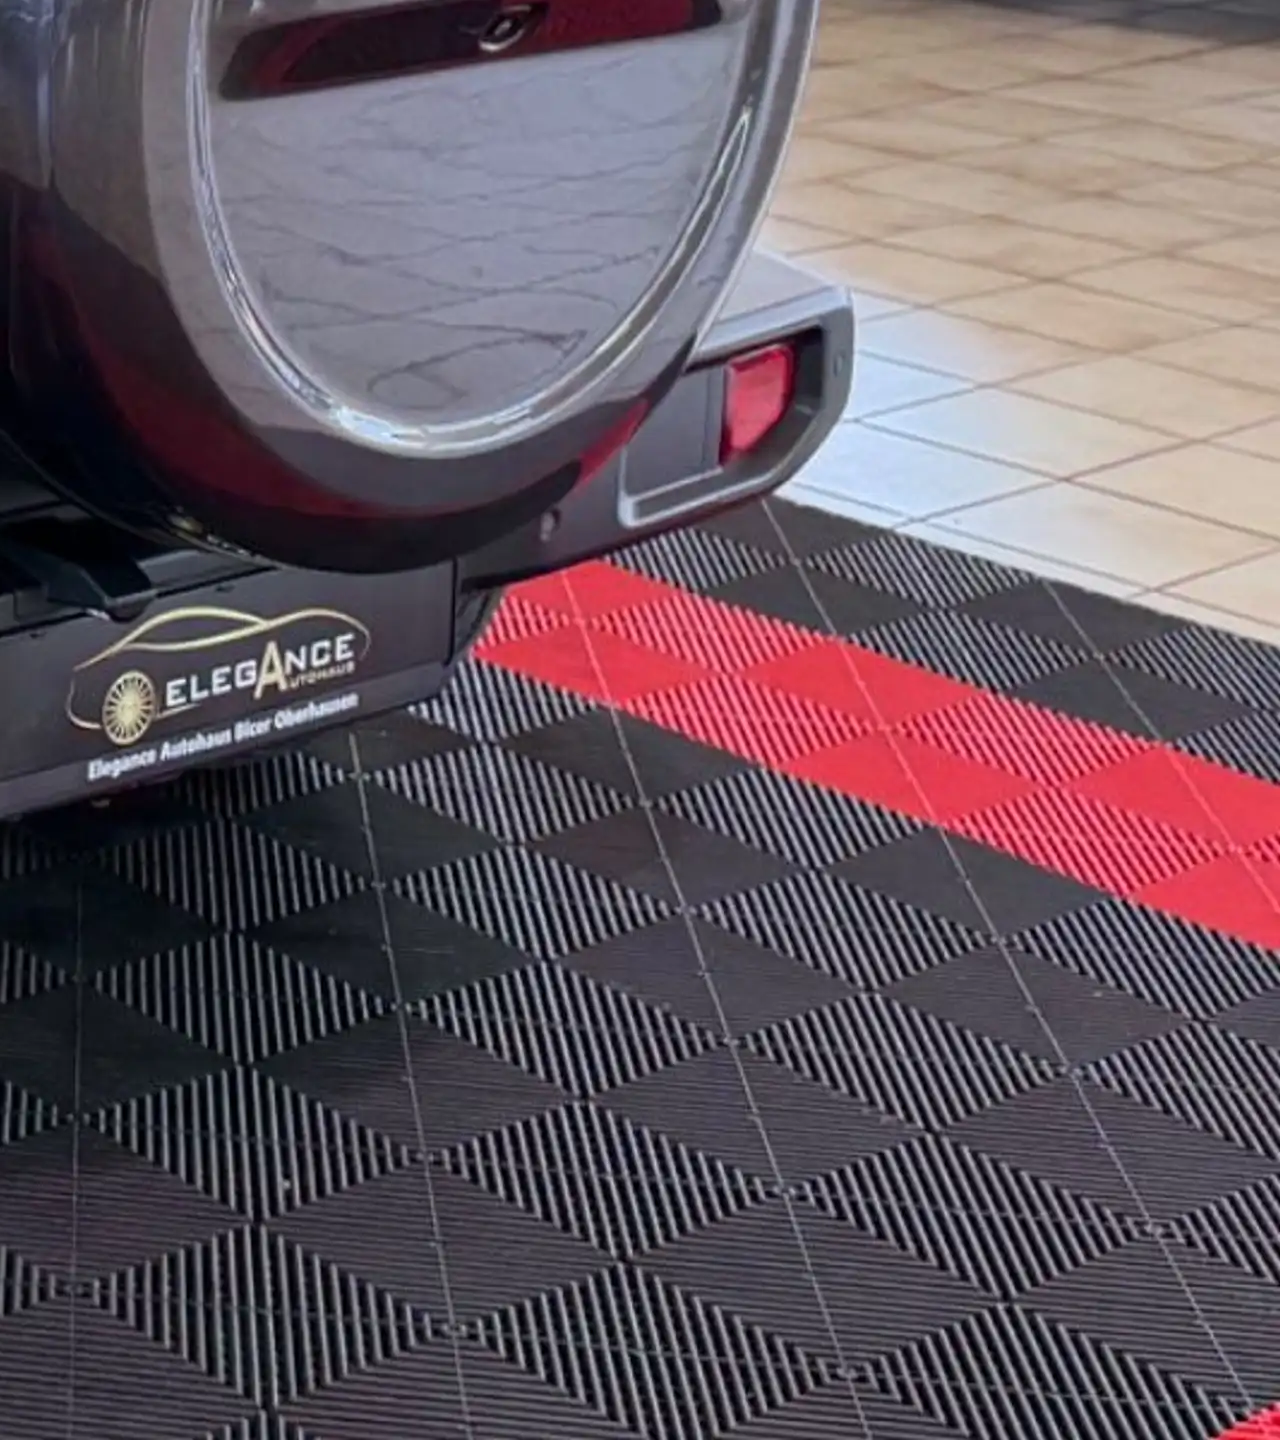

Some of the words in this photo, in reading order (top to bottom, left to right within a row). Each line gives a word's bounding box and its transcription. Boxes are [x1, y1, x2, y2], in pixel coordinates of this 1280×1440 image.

[165, 632, 355, 700] ELEGANCE
[88, 748, 158, 781] Elegance
[159, 727, 233, 761] Autohaus
[273, 692, 360, 730] Oberhausen
